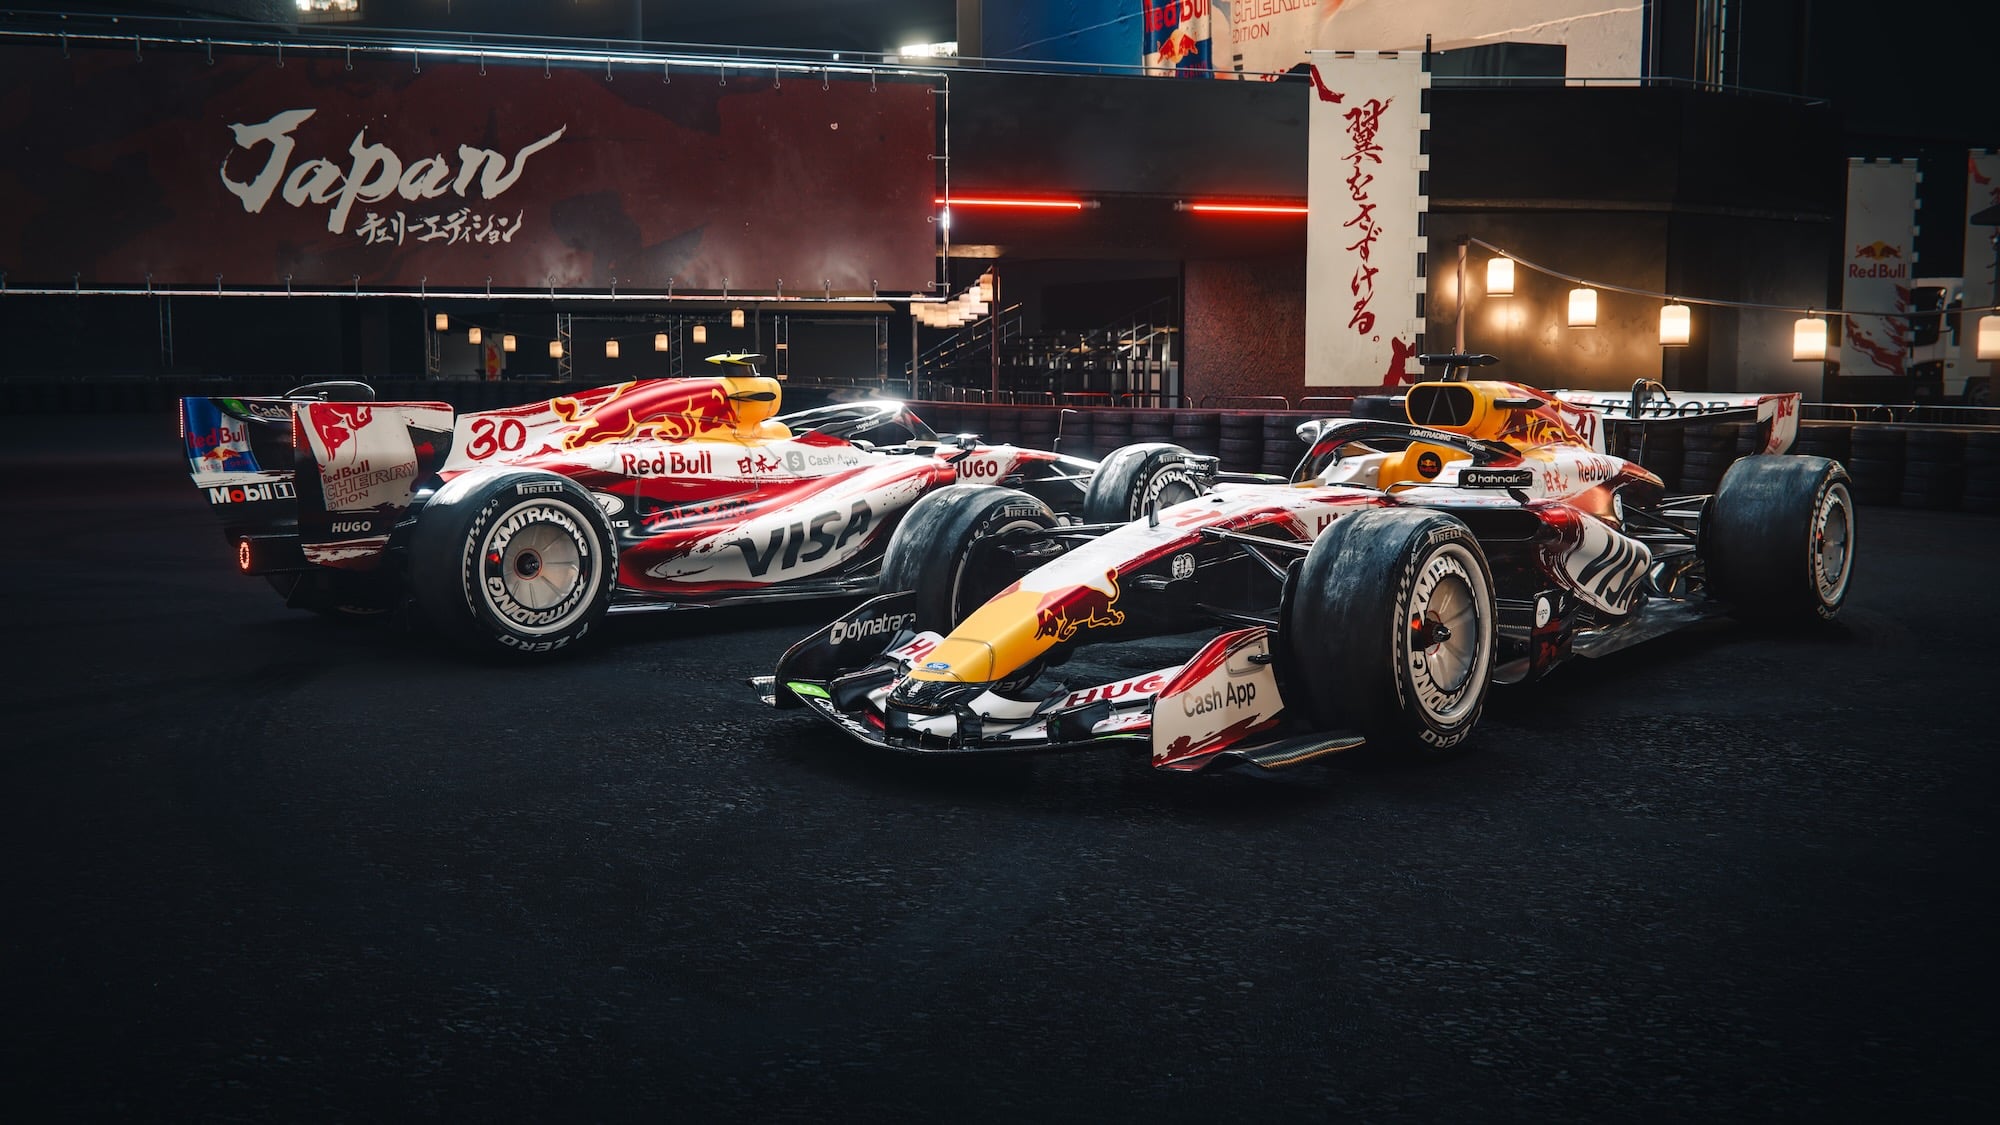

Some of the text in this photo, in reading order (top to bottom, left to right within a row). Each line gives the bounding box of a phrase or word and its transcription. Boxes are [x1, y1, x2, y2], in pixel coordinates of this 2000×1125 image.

[220, 107, 567, 233] Japan
[356, 207, 523, 246] チェリーエディション
[1849, 263, 1906, 278] Red Bull
[249, 403, 290, 418] Cash
[219, 423, 246, 444] Bull
[466, 418, 527, 460] 30
[621, 450, 712, 475] Red Bull
[808, 453, 834, 466] Cash
[1575, 456, 1614, 483] Red Bull
[323, 460, 370, 485] Red Bull
[325, 461, 416, 500] CHERRY
[1477, 473, 1520, 484] hahnair
[209, 483, 273, 504] Mobil
[516, 481, 563, 496] PIRELLI
[1003, 504, 1041, 518] PIRELLI
[331, 521, 372, 533] HUGO
[492, 506, 588, 560] XMTRADING
[722, 499, 872, 578] VISA
[1427, 524, 1463, 545] PIRELLI
[488, 576, 586, 625] XMTRADING
[497, 634, 571, 652] ZERO
[1182, 681, 1256, 718] Cash App
